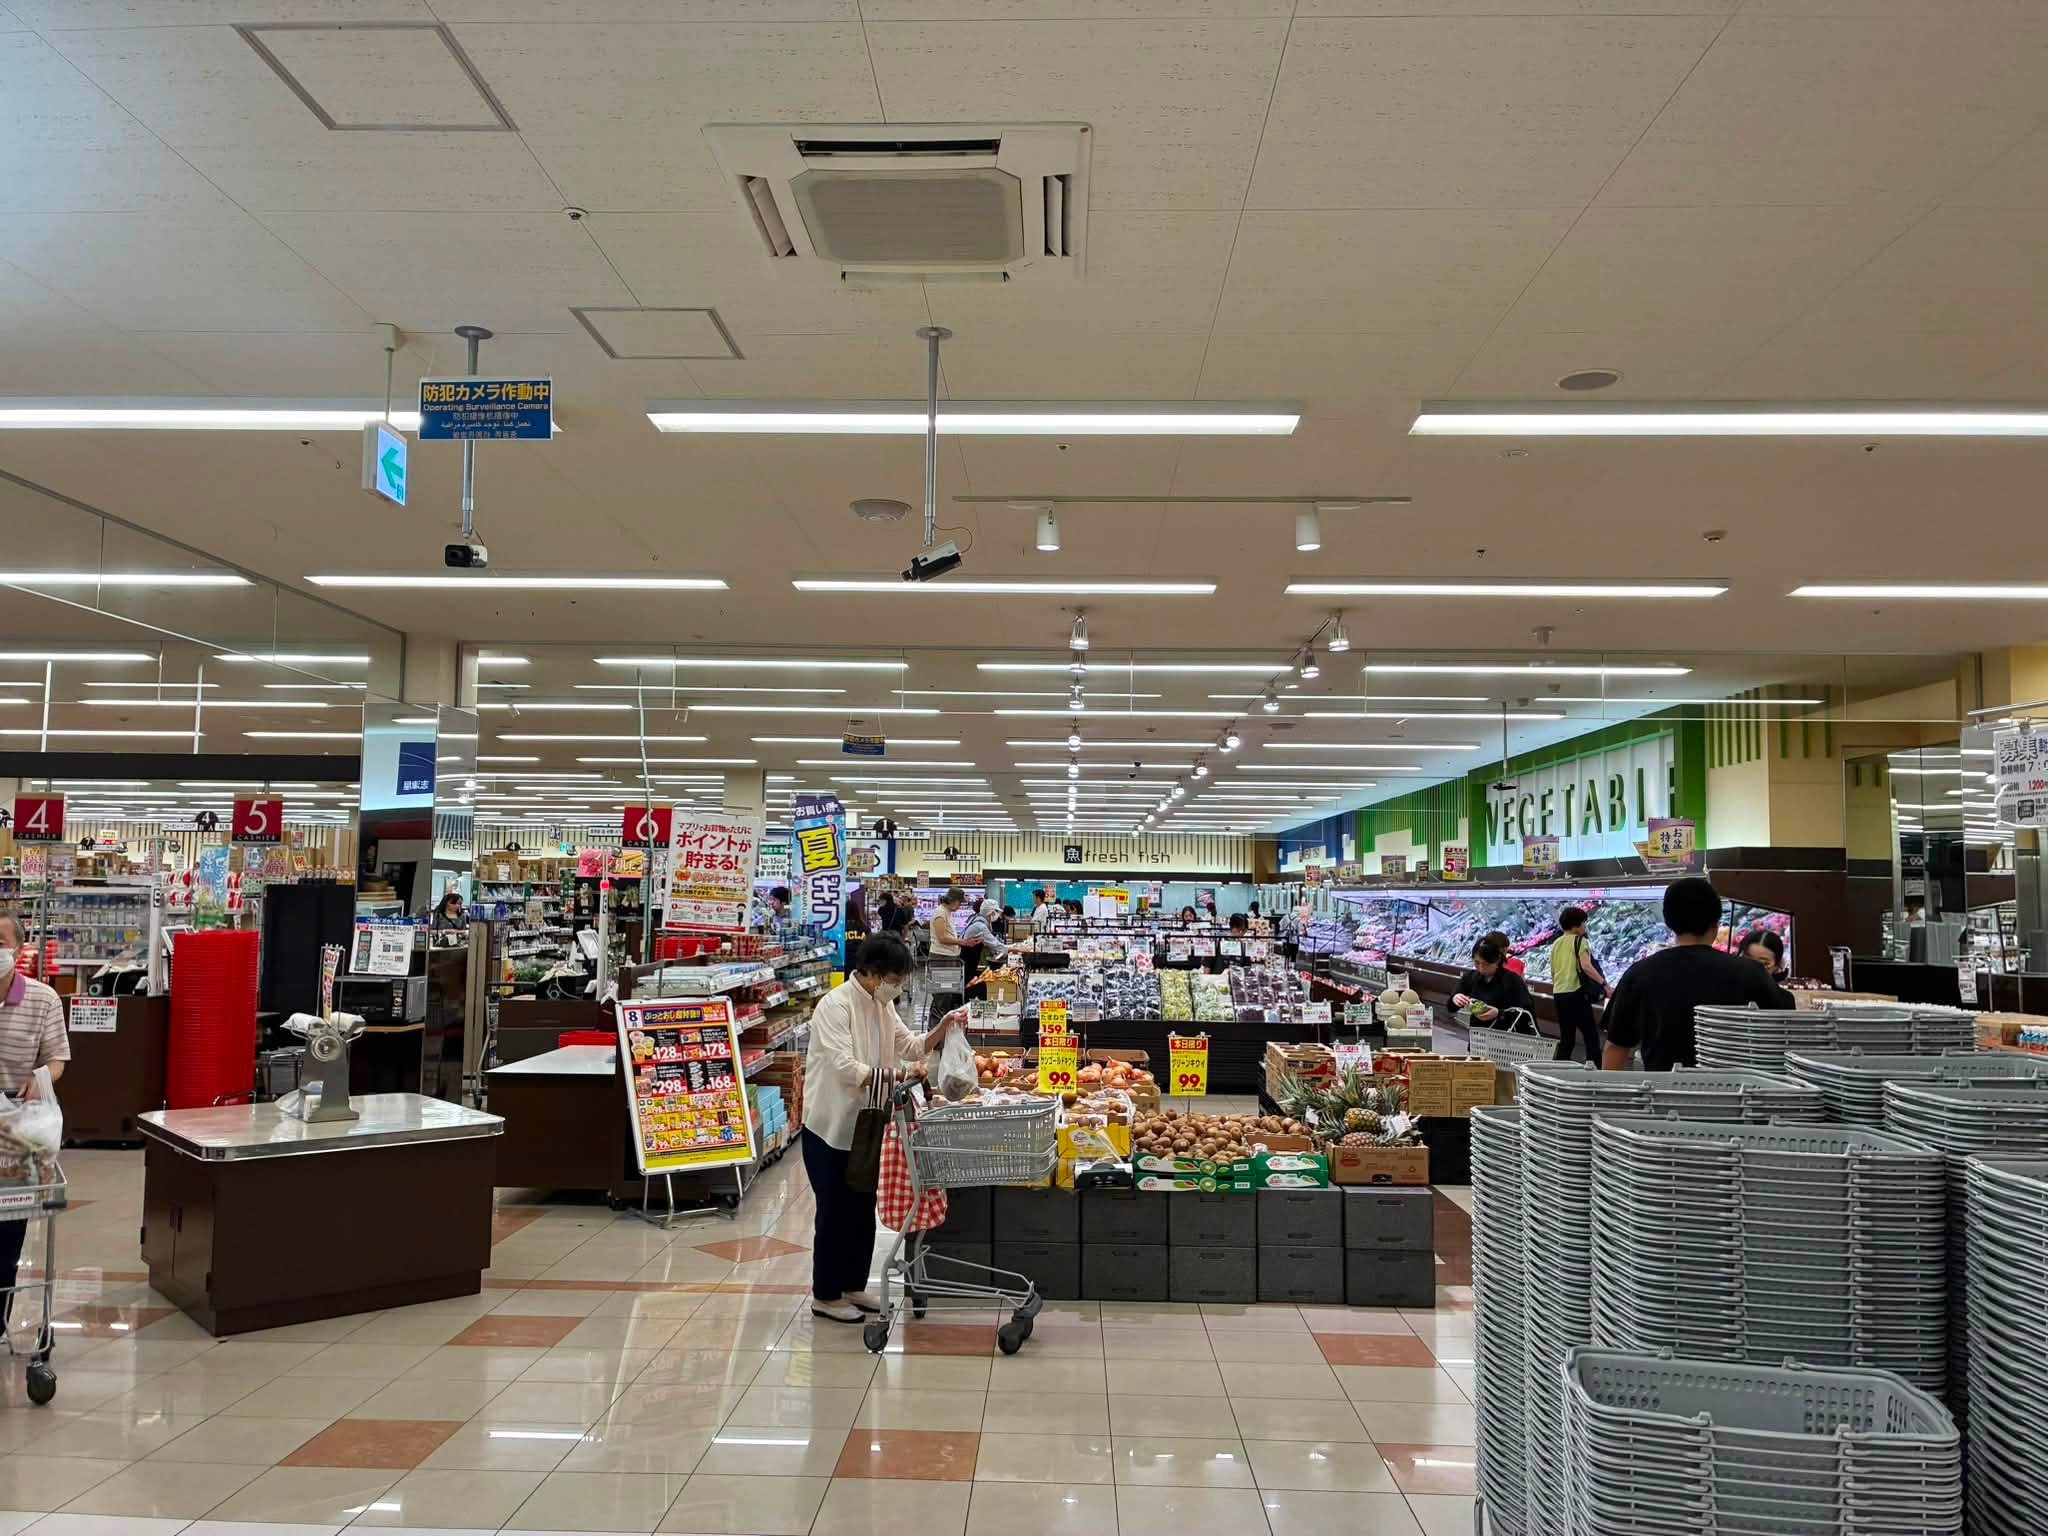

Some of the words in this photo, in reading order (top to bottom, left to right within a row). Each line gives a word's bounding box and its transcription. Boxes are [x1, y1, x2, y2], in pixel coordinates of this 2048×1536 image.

[423, 383, 549, 402] 防犯カメラ作動中
[423, 403, 464, 411] Operating
[465, 402, 515, 411] Surveillance
[517, 402, 549, 410] Camera
[25, 800, 49, 833] 4
[244, 800, 268, 834] 5
[636, 808, 659, 841] 6
[676, 831, 752, 852] ポイントが
[1066, 847, 1081, 862] 魚
[1084, 850, 1129, 863] fresh
[1138, 850, 1171, 863] fish
[628, 1010, 637, 1022] 8
[1044, 1037, 1073, 1047] 本日限り
[1174, 1040, 1203, 1049] 本日限り
[655, 1046, 677, 1060] 128
[704, 1043, 726, 1056] 178
[1171, 1058, 1205, 1068] グリーンキウイ
[657, 1080, 681, 1093] 298
[711, 1076, 732, 1089] 168
